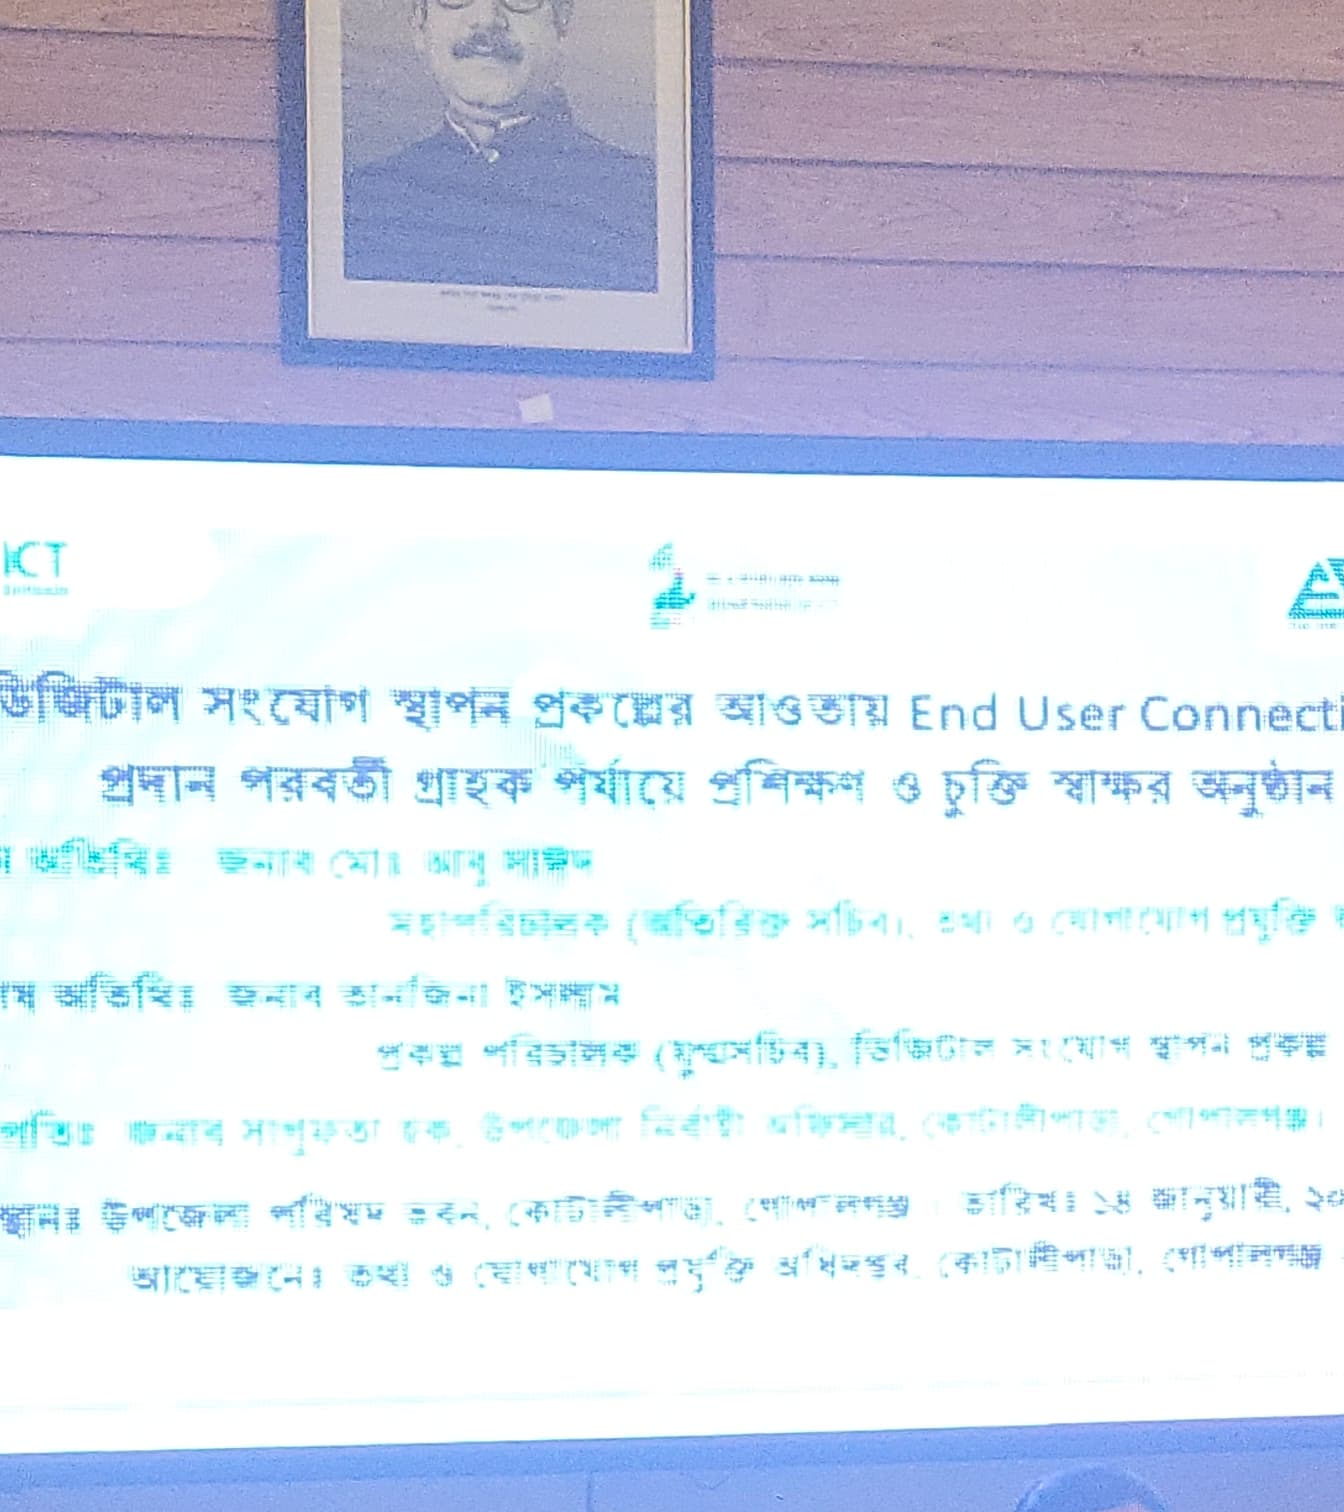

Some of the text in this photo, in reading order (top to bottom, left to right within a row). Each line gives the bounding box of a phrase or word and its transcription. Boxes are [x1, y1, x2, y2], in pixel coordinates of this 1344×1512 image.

[200, 685, 371, 726] সংযোগ
[391, 686, 511, 732] স্থাপন
[532, 688, 694, 730] প্রকল্পের
[721, 691, 890, 728] আওতায়
[910, 692, 998, 732] End
[1018, 695, 1126, 732] User
[99, 755, 1334, 819] প্রদান পরবর্তী গ্রাহক পর্যায়ে প্রশিক্ষণ ও চুক্তি স্বাক্ষর অনুষ্ঠান
[215, 846, 315, 877] জনাব
[224, 980, 324, 1010] জনাব
[126, 1117, 225, 1147] জনাব
[99, 1197, 251, 1236] উপজেলা
